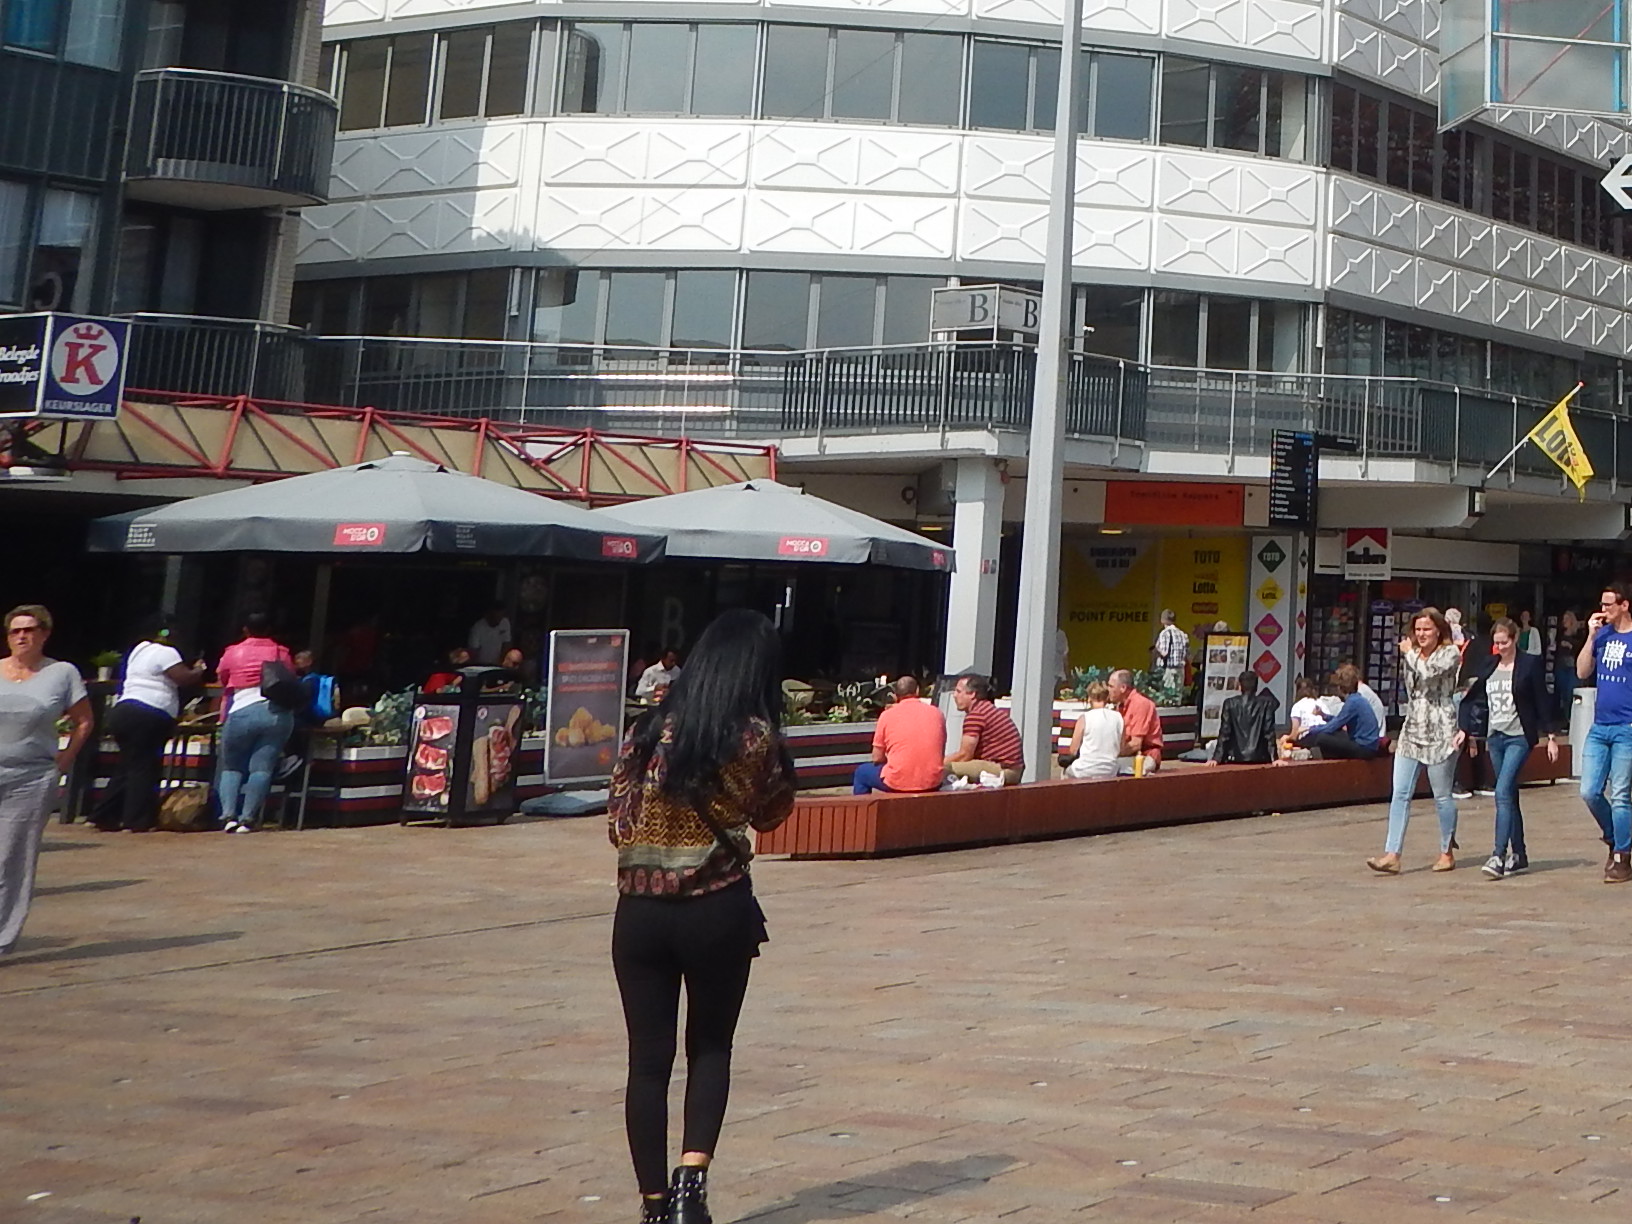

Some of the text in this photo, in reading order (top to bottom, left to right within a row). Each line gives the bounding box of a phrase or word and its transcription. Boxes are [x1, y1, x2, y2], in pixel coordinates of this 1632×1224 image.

[59, 341, 108, 386] K
[0, 366, 40, 385] roodjes
[44, 399, 112, 413] KEURSLAGER
[1194, 550, 1221, 564] TOTO
[1069, 611, 1149, 623] POINT FUMEE
